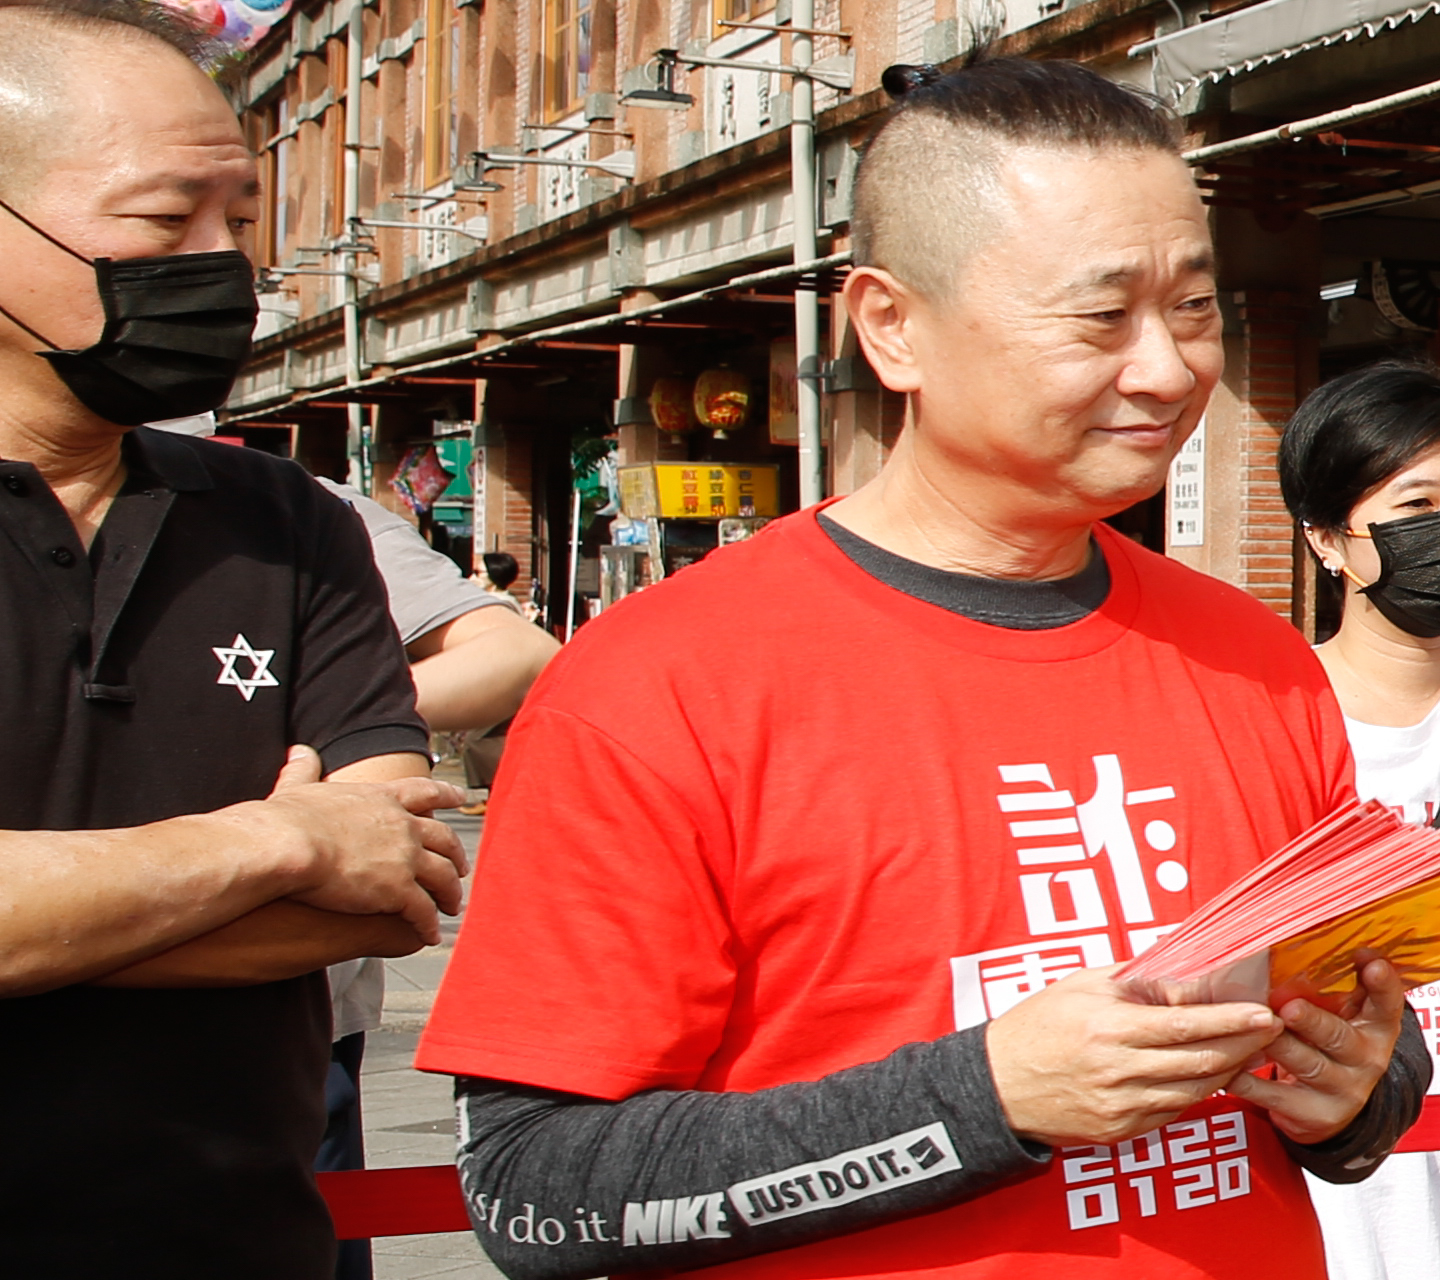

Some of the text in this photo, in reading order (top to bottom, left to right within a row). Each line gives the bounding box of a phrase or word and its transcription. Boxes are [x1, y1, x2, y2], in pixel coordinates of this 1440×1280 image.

[746, 1174, 819, 1219] JUST
[818, 1160, 871, 1200] DO
[508, 1203, 567, 1245] do
[574, 1207, 620, 1243] it.
[622, 1191, 732, 1247] NIKE
